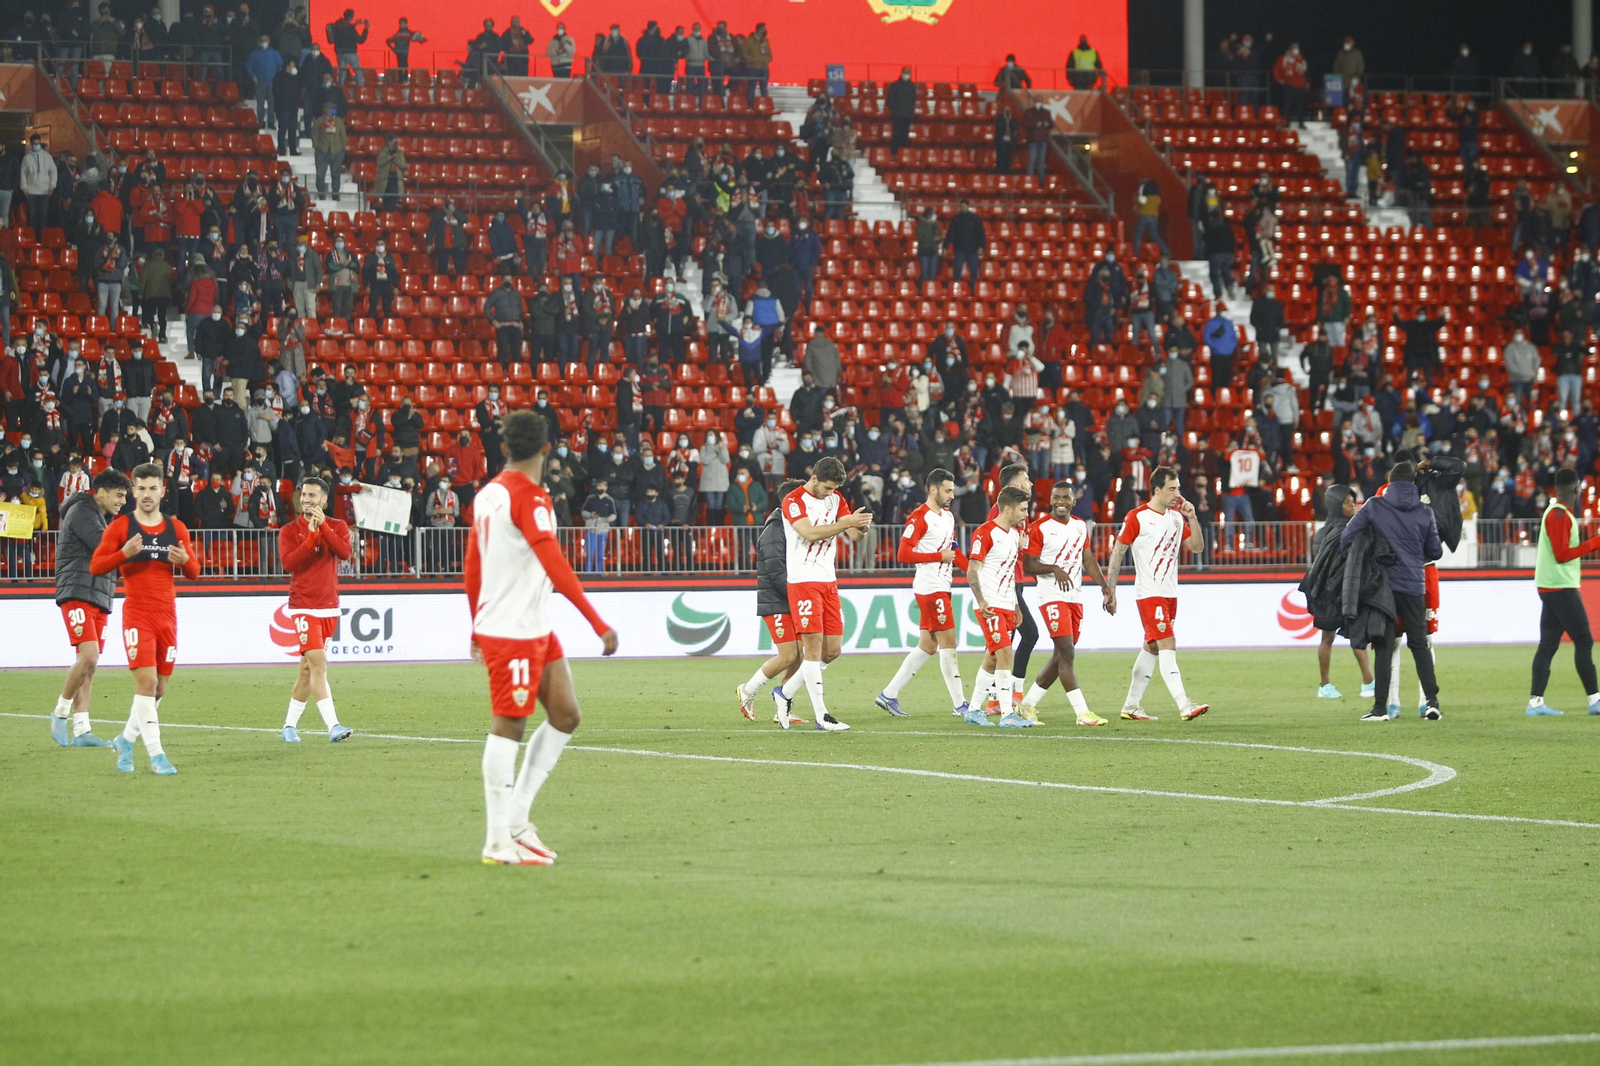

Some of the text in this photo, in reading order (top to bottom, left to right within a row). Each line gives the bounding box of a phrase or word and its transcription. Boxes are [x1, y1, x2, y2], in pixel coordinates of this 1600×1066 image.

[1238, 457, 1252, 472] 10
[797, 599, 813, 616] 22
[935, 598, 945, 614] 3
[1046, 604, 1060, 621] 15
[1154, 605, 1165, 621] 4
[68, 607, 86, 626] 30
[294, 615, 309, 633] 16
[986, 615, 999, 632] 17
[124, 627, 139, 647] 10
[331, 645, 394, 654] GECOMP
[507, 658, 530, 686] 11
